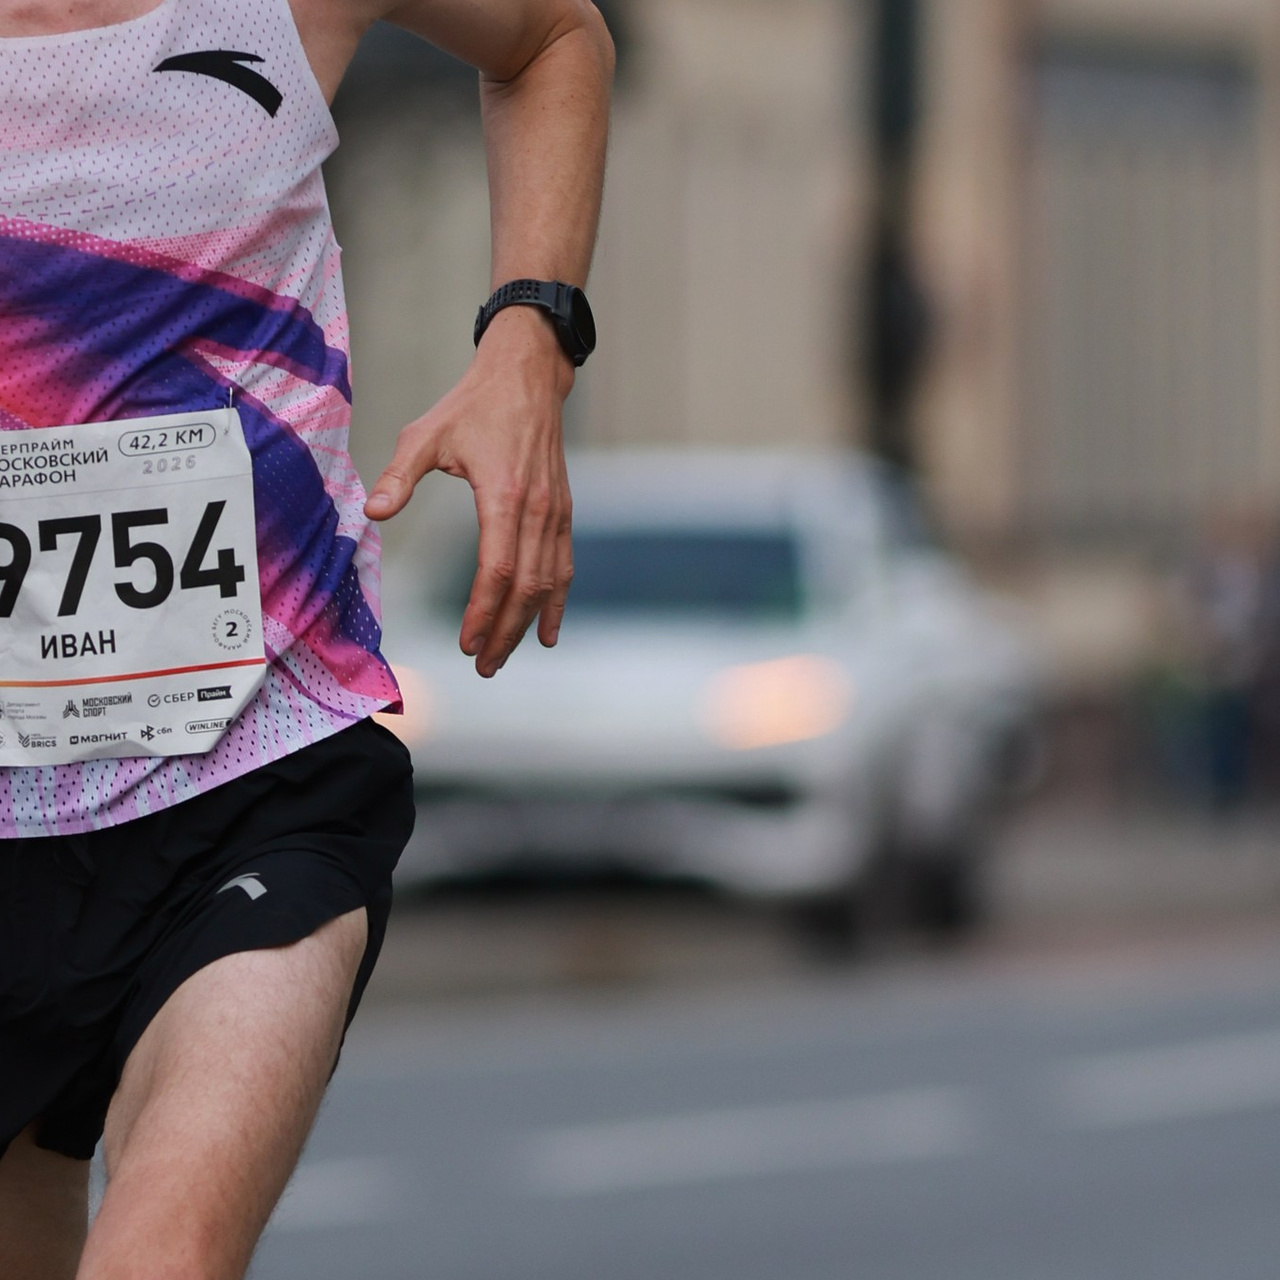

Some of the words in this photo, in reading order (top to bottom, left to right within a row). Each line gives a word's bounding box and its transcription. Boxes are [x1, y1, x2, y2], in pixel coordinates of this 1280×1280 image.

[129, 432, 168, 451] 42,2
[175, 428, 204, 446] КМ
[141, 454, 197, 475] 2026
[225, 621, 239, 638] 2
[40, 629, 117, 659] ИВАН
[81, 692, 133, 708] МОСКОВСКИЙ
[163, 691, 195, 704] СБЕР
[200, 689, 227, 700] Прайм
[82, 706, 107, 718] СПОРТ
[156, 726, 173, 735] сбп
[189, 720, 225, 732] WINLINE
[31, 739, 57, 748] BRICS
